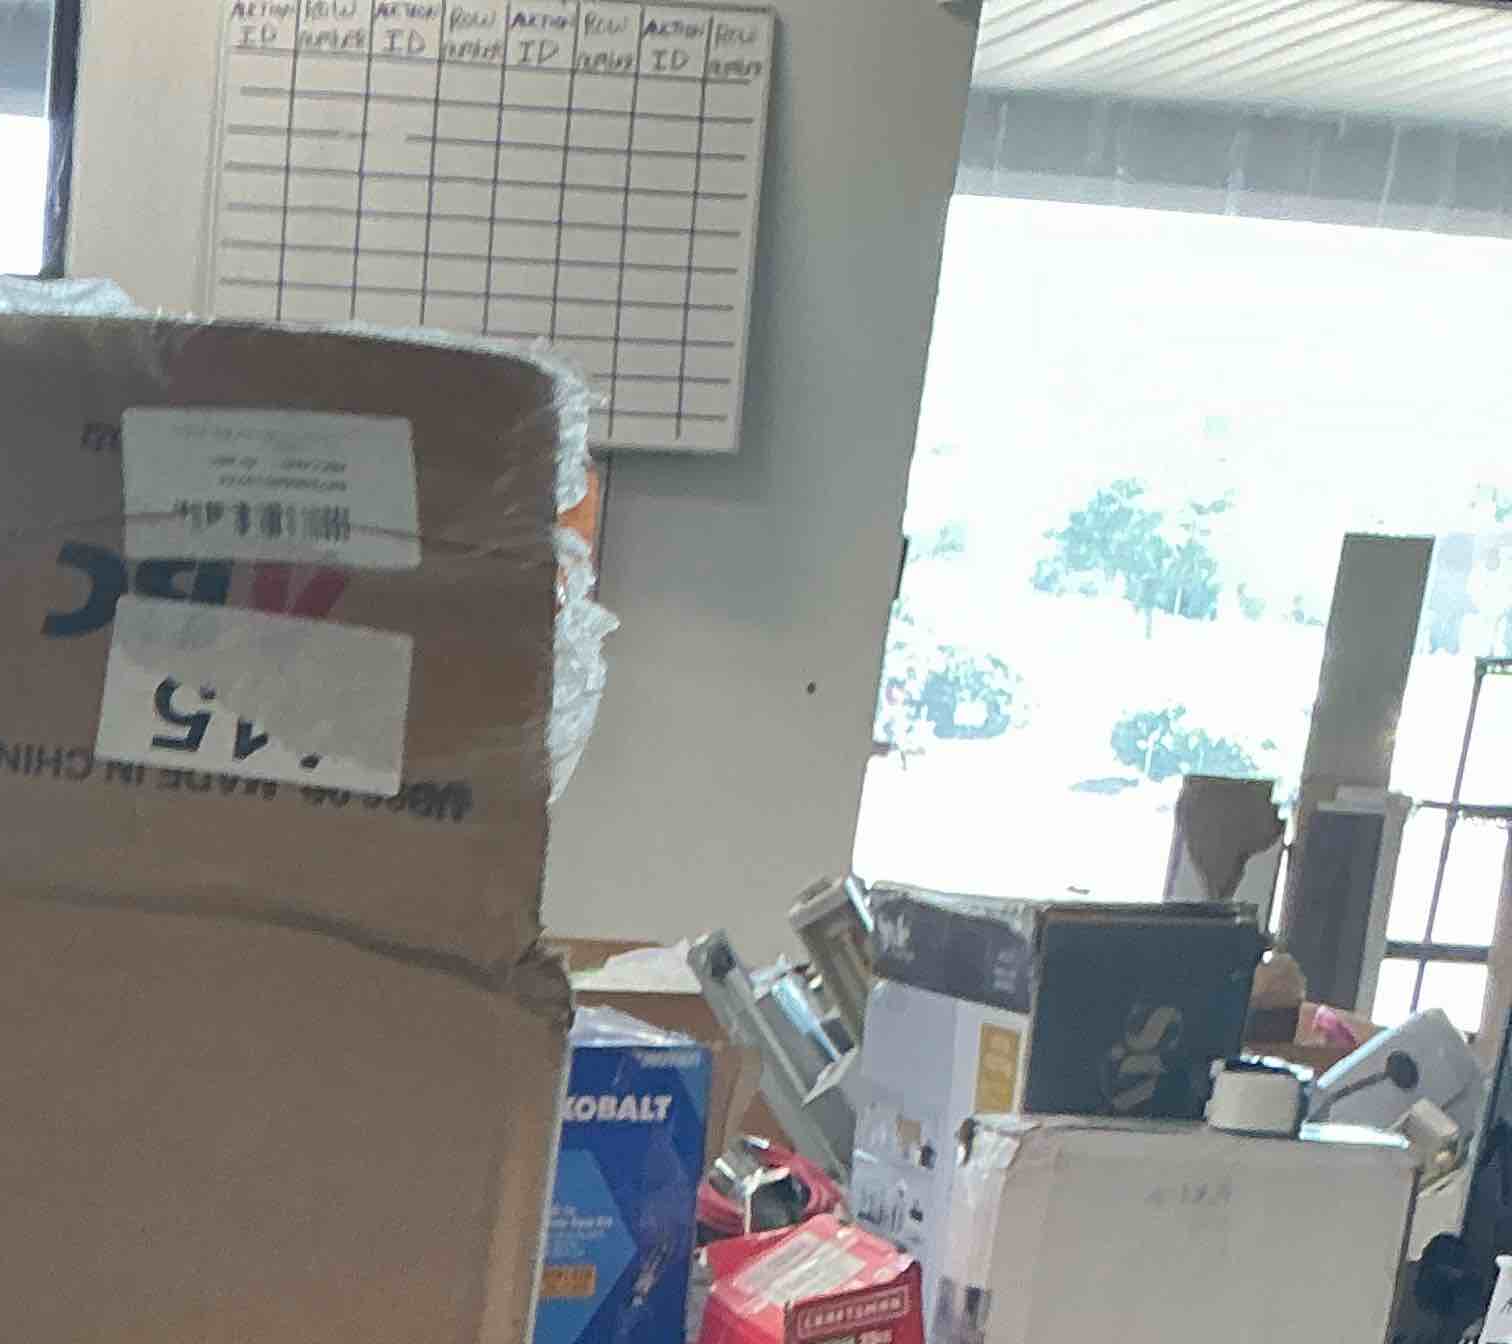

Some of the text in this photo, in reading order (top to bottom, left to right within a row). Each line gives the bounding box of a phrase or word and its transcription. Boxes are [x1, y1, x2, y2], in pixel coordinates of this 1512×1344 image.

[383, 29, 425, 53] ID
[519, 40, 559, 63] ID
[651, 49, 689, 71] ID
